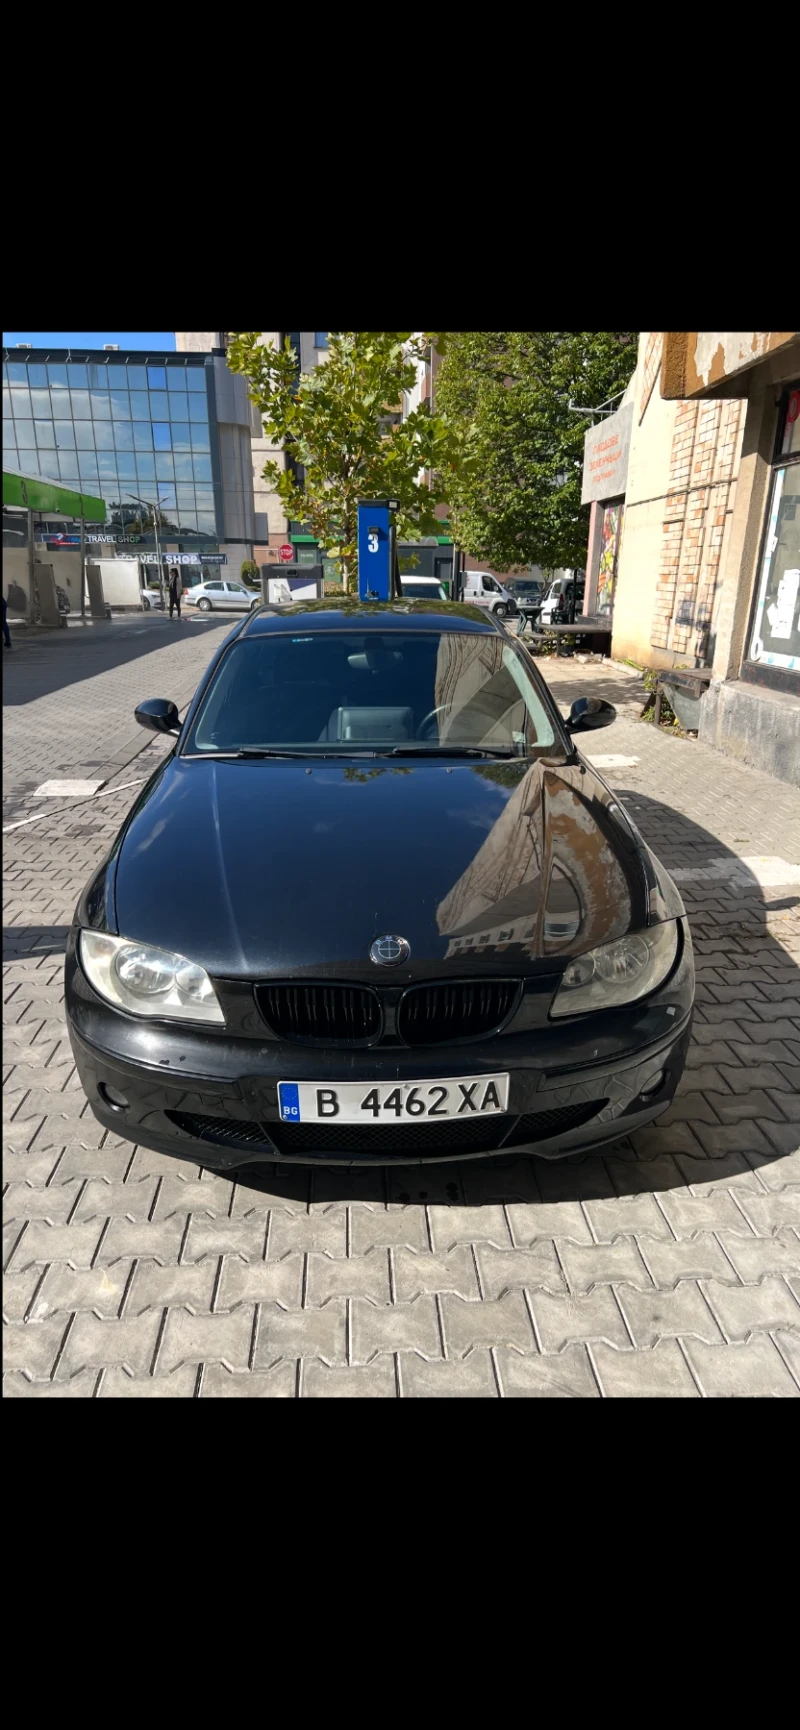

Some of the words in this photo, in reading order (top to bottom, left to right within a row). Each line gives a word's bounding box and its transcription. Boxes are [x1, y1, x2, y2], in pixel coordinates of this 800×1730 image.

[21, 480, 28, 504] 3
[88, 535, 116, 543] TRAVEL
[368, 533, 379, 553] 3
[165, 555, 198, 564] SHOP
[283, 1106, 298, 1115] BG
[316, 1089, 339, 1117] B
[361, 1086, 448, 1117] 4462
[457, 1080, 501, 1113] XA
